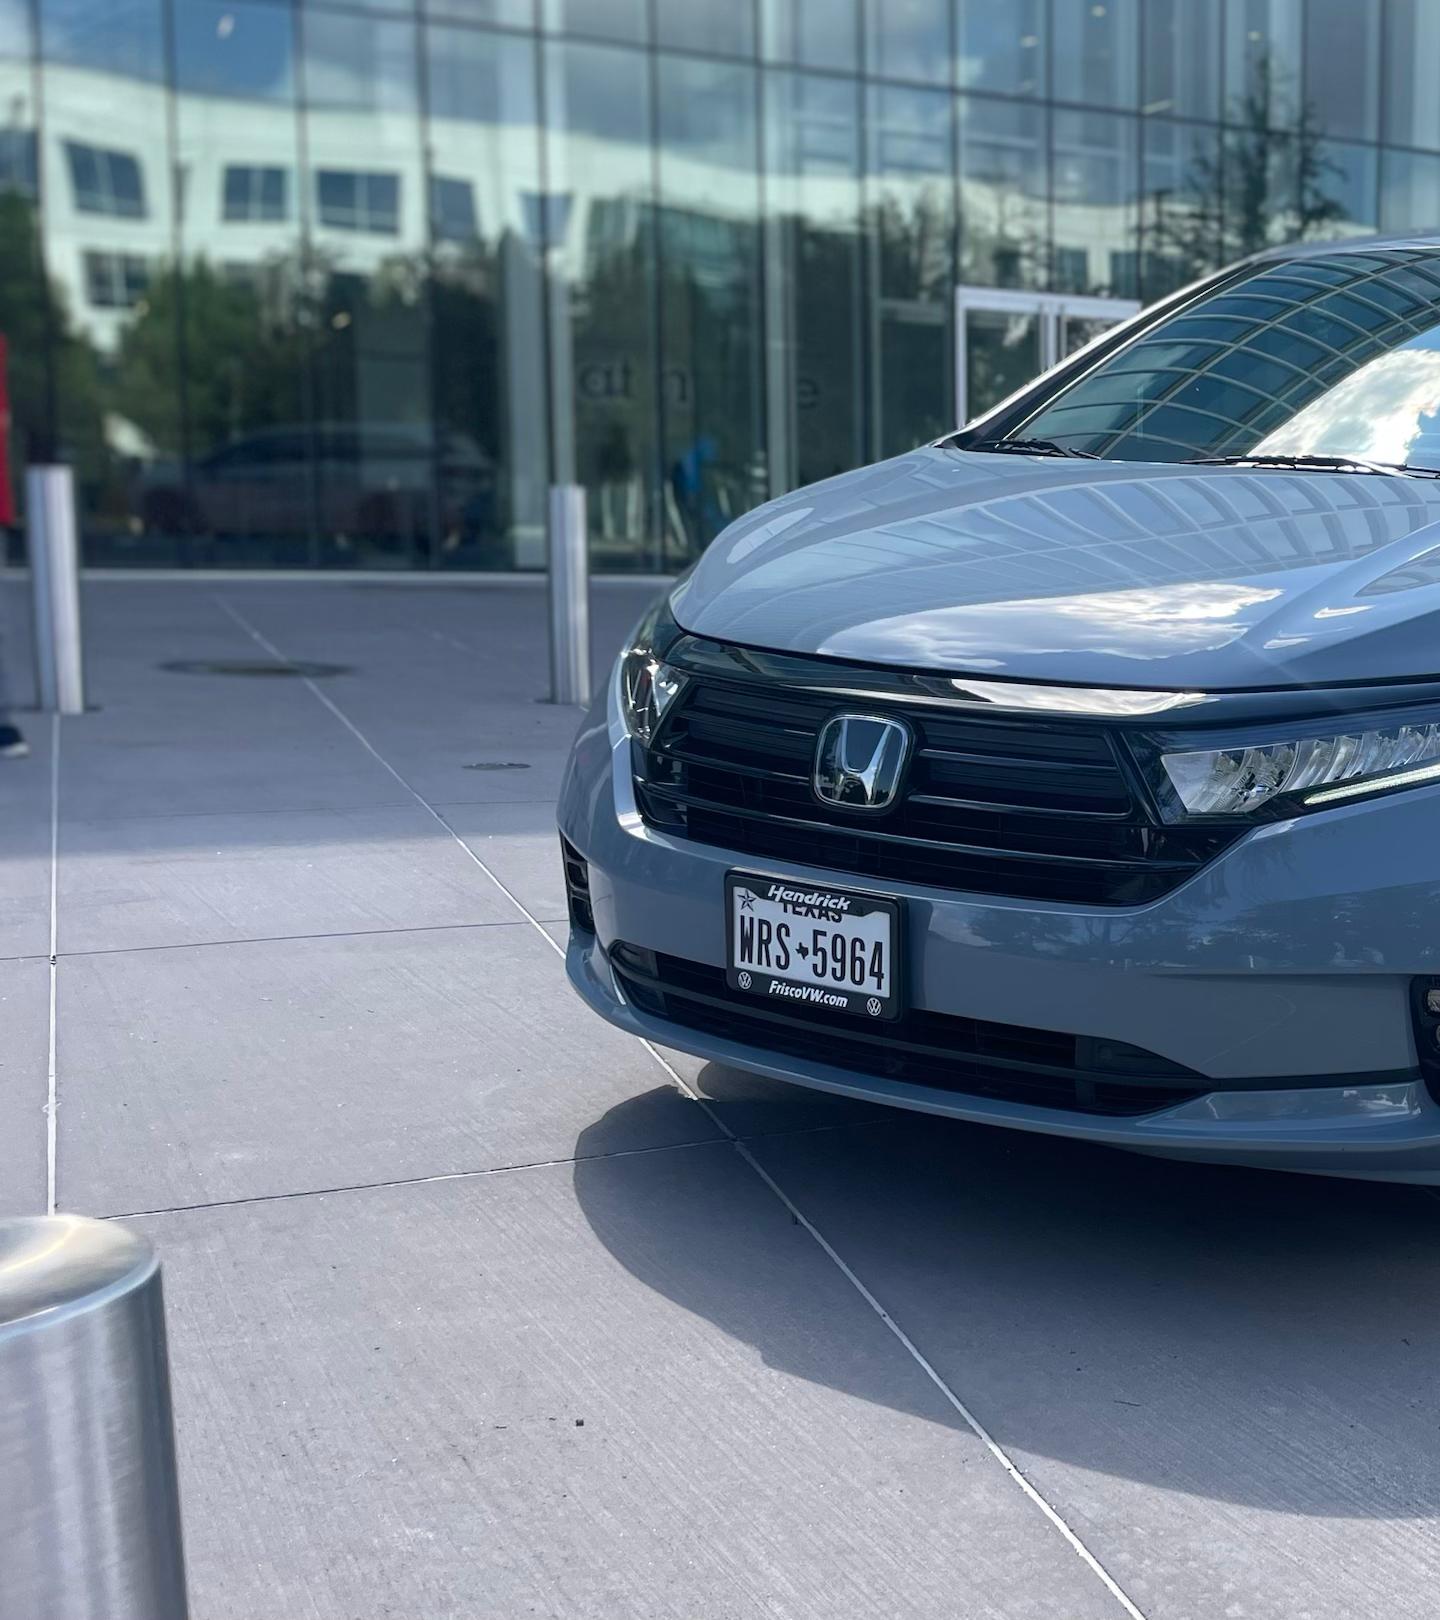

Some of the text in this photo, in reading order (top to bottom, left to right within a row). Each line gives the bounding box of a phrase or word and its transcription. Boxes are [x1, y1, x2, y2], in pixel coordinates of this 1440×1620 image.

[768, 885, 850, 910] Hendrick
[740, 915, 885, 990] WRS 5964
[769, 980, 848, 1008] FriscoVW.com
